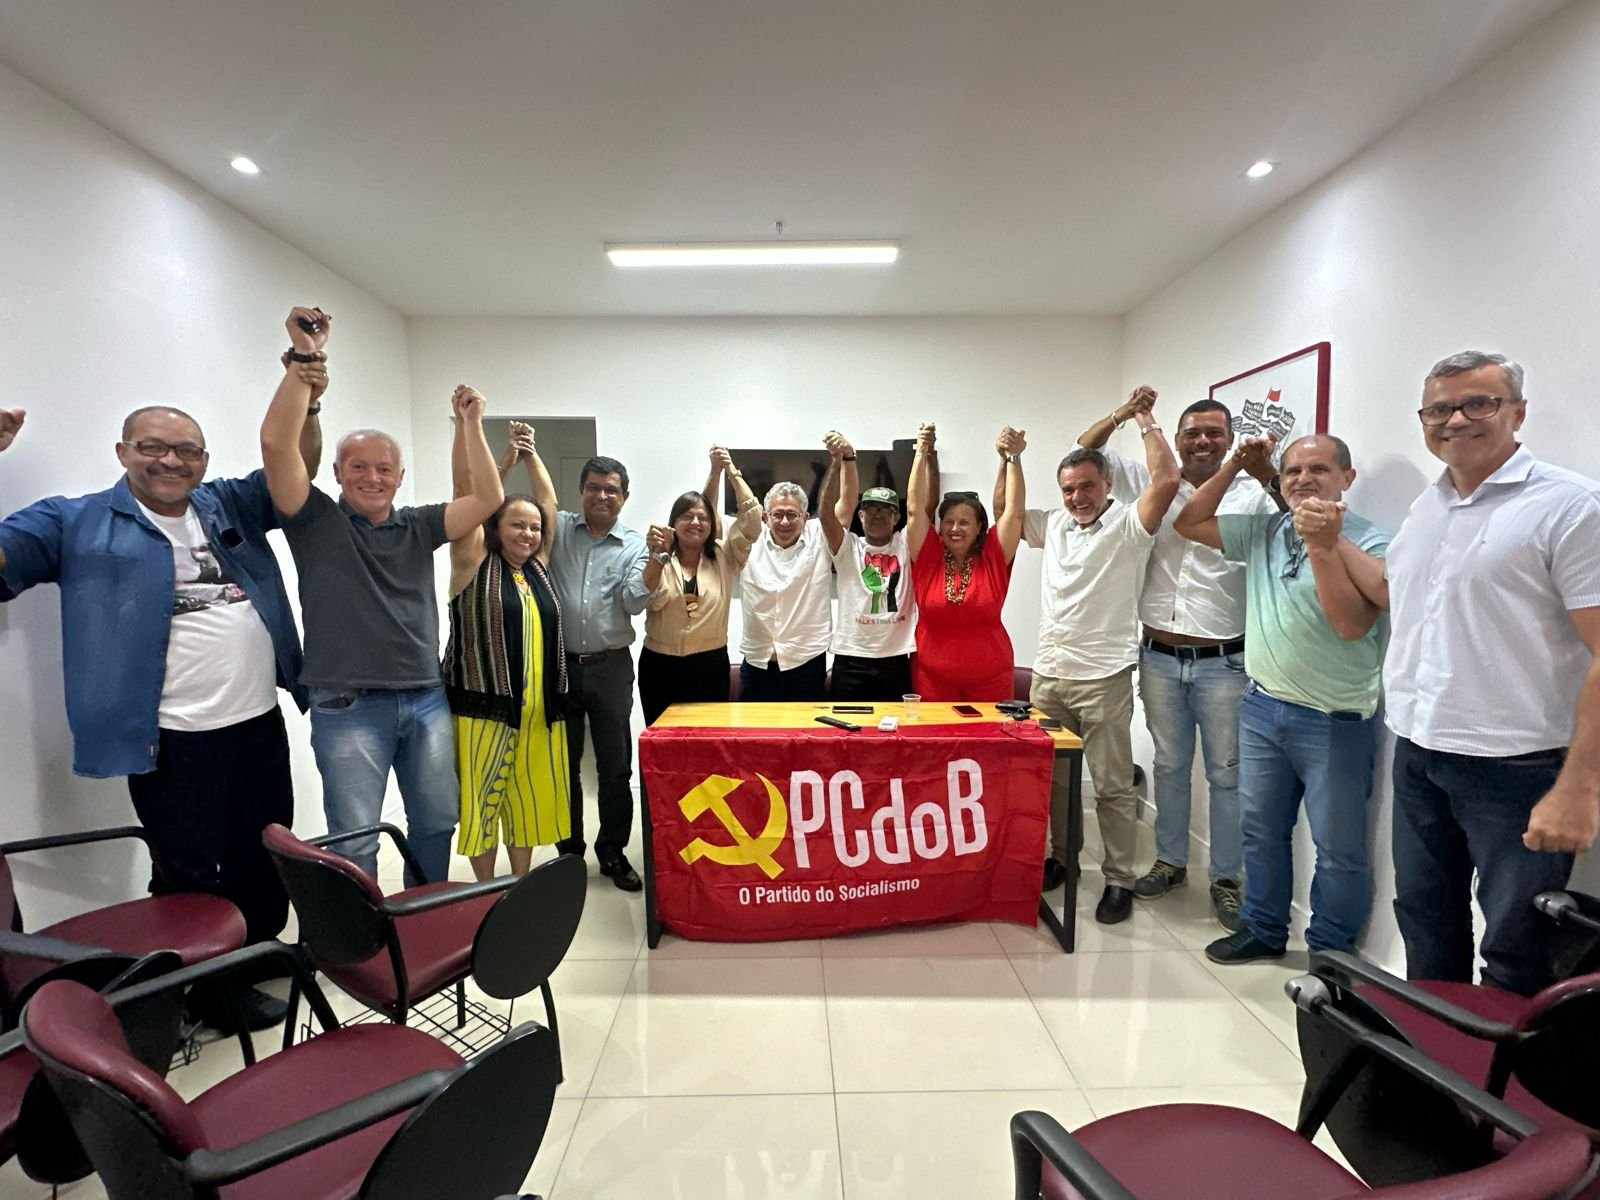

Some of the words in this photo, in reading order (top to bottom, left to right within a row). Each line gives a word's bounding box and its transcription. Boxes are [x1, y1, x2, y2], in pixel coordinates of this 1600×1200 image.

[789, 758, 989, 869] PCdoB
[738, 887, 751, 905] O
[755, 886, 811, 904] Partido
[815, 886, 834, 902] do
[838, 878, 920, 901] Socialismo
